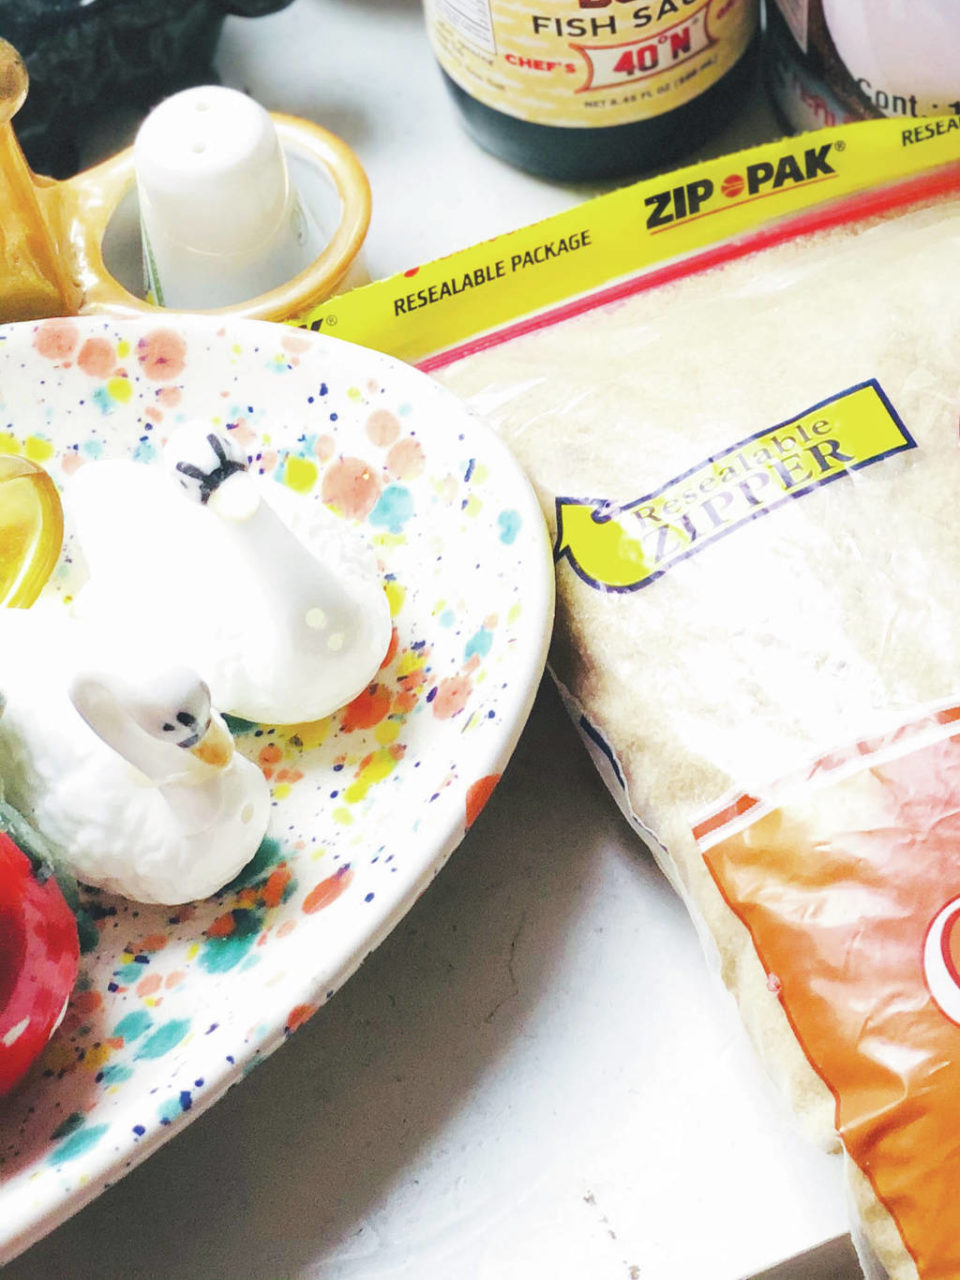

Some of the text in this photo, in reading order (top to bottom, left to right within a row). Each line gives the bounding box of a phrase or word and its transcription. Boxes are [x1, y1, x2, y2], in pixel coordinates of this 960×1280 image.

[532, 15, 617, 37] FISH
[504, 53, 577, 74] CHEF'S
[644, 178, 714, 230] ZIP
[393, 229, 592, 317] RESEALABLE PACKAGE
[633, 419, 833, 528] Resealable
[642, 439, 855, 564] ZIPPER
